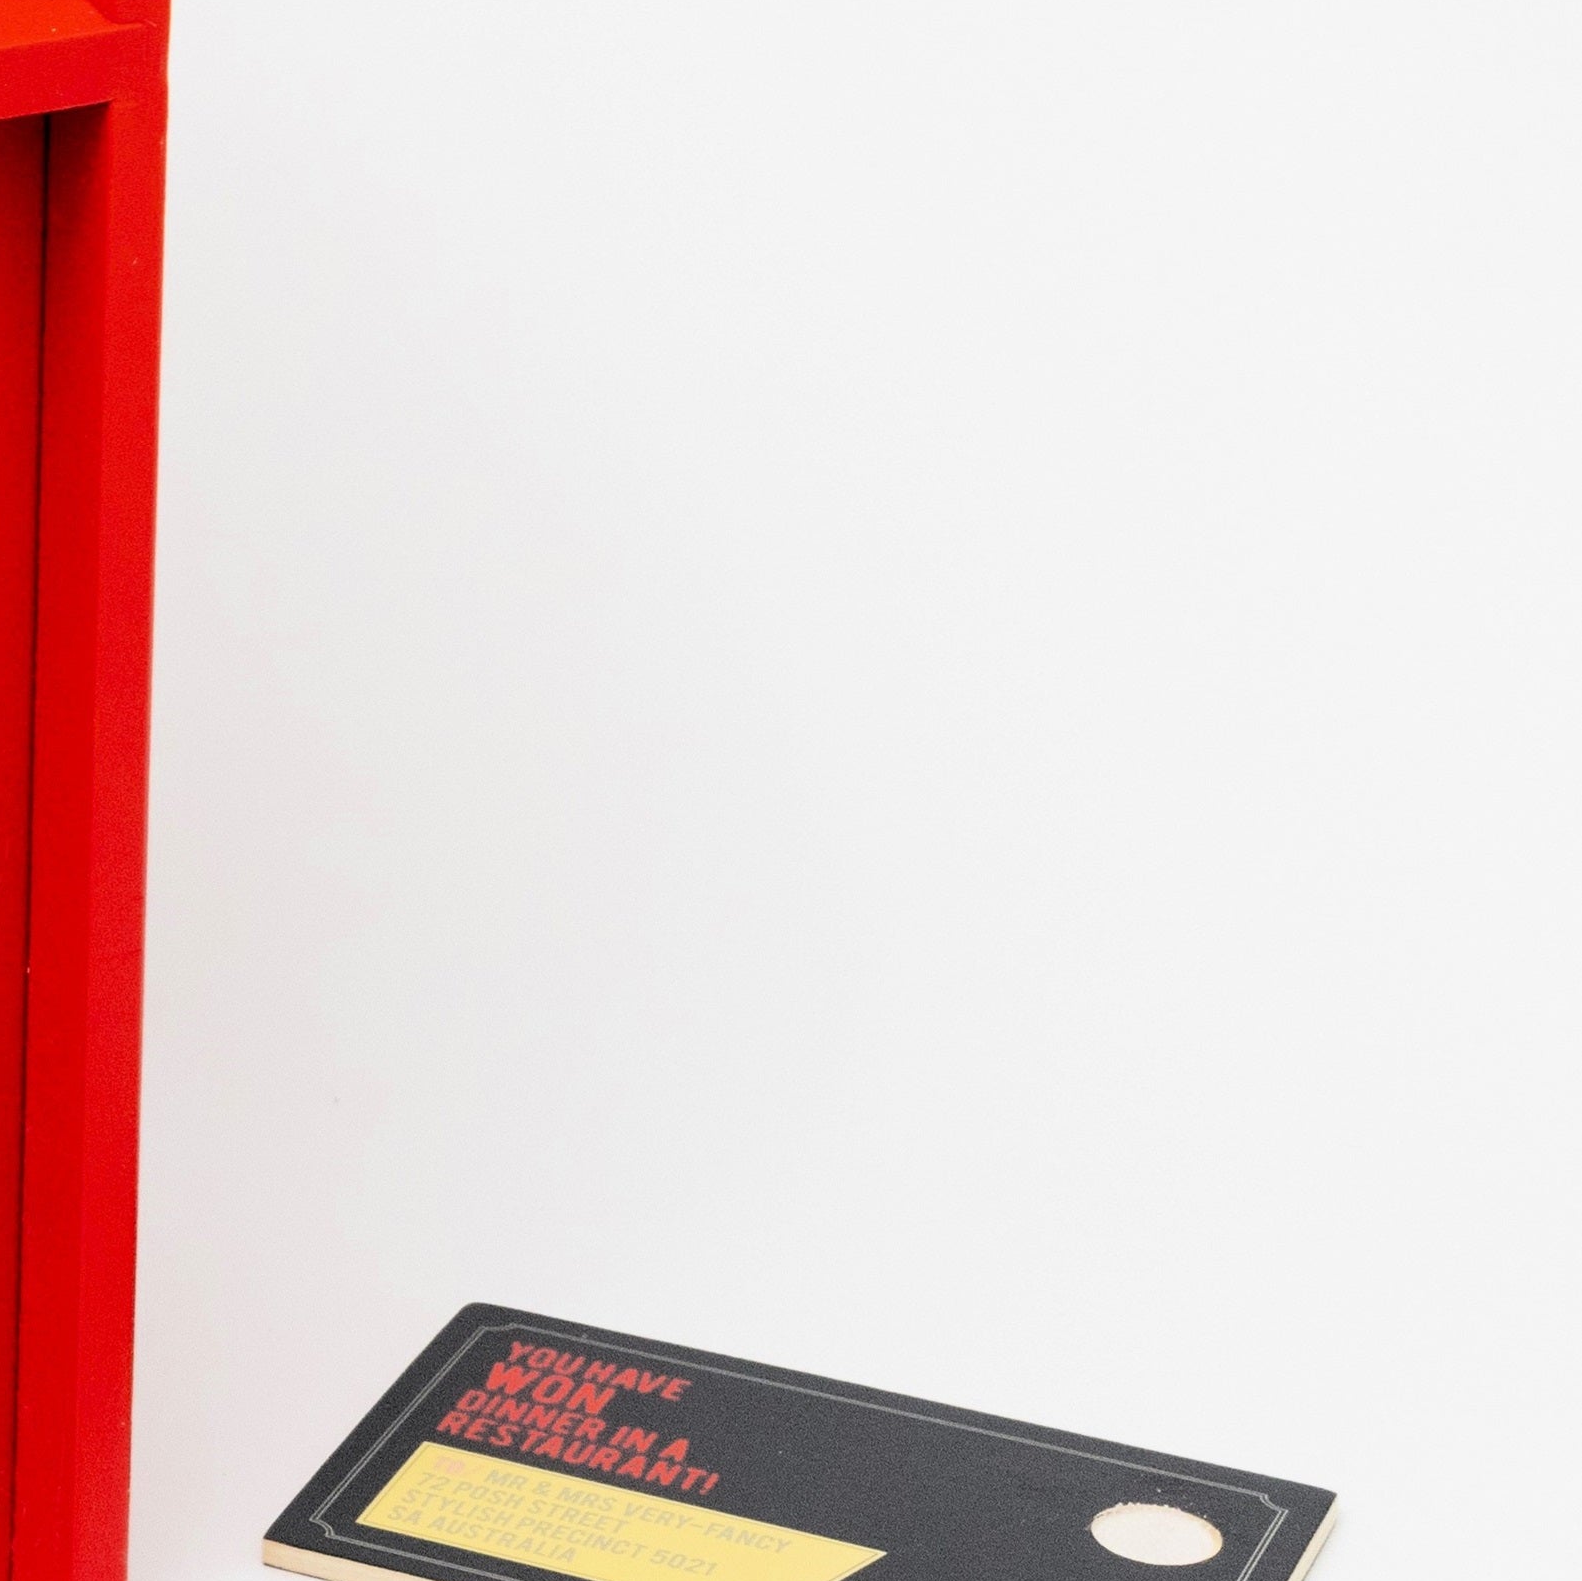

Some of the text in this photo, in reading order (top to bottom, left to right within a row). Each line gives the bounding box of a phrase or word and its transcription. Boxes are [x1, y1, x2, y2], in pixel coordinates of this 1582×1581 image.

[485, 1362, 616, 1415] WON
[509, 1340, 693, 1402] YOU HAVE
[437, 1413, 721, 1496] RESTAURANT!
[455, 1390, 690, 1461] DINNER IN A
